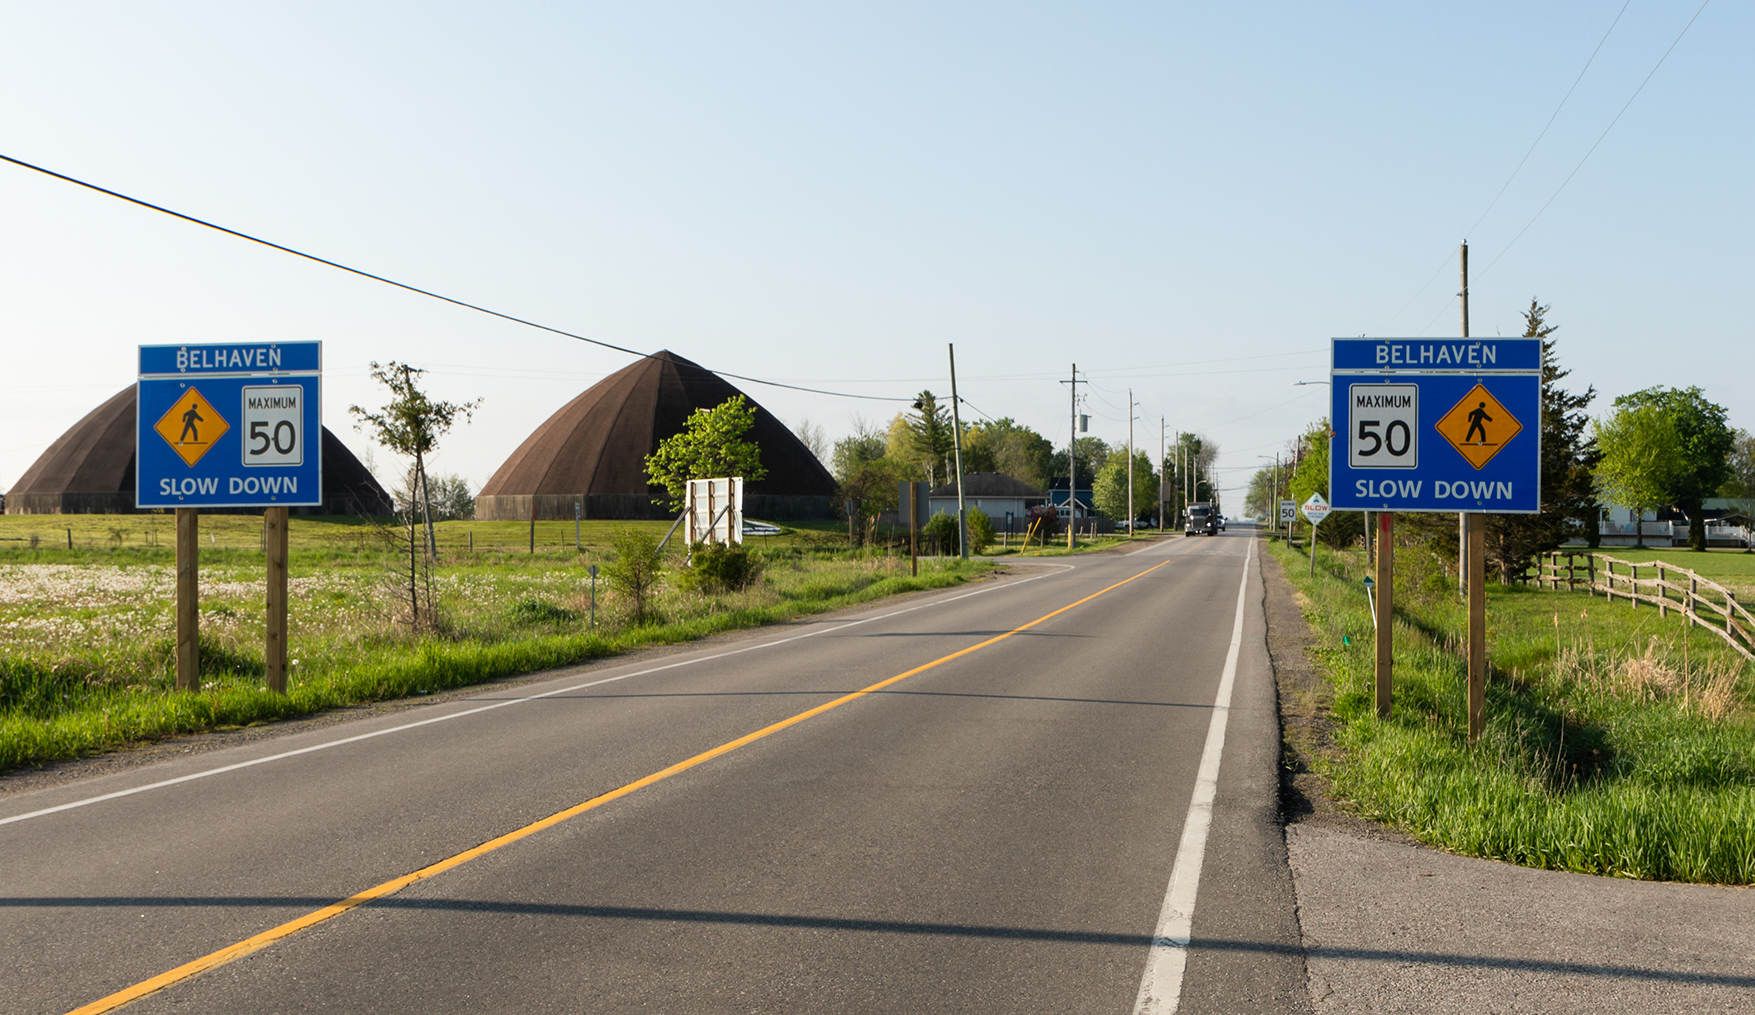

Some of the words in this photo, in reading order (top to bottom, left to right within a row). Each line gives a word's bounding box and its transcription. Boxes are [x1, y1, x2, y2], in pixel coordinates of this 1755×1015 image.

[176, 349, 281, 369] BELHAVEN
[1376, 345, 1497, 364] BELHAVEN
[248, 397, 297, 410] MAXIMUM
[1356, 395, 1411, 408] MAXIMUM
[249, 420, 296, 455] 50
[1358, 419, 1411, 457] 50
[159, 477, 219, 496] SLOW
[229, 476, 298, 494] DOWN
[1355, 479, 1422, 498] SLOW
[1435, 481, 1513, 500] DOWN
[1282, 508, 1295, 518] 50
